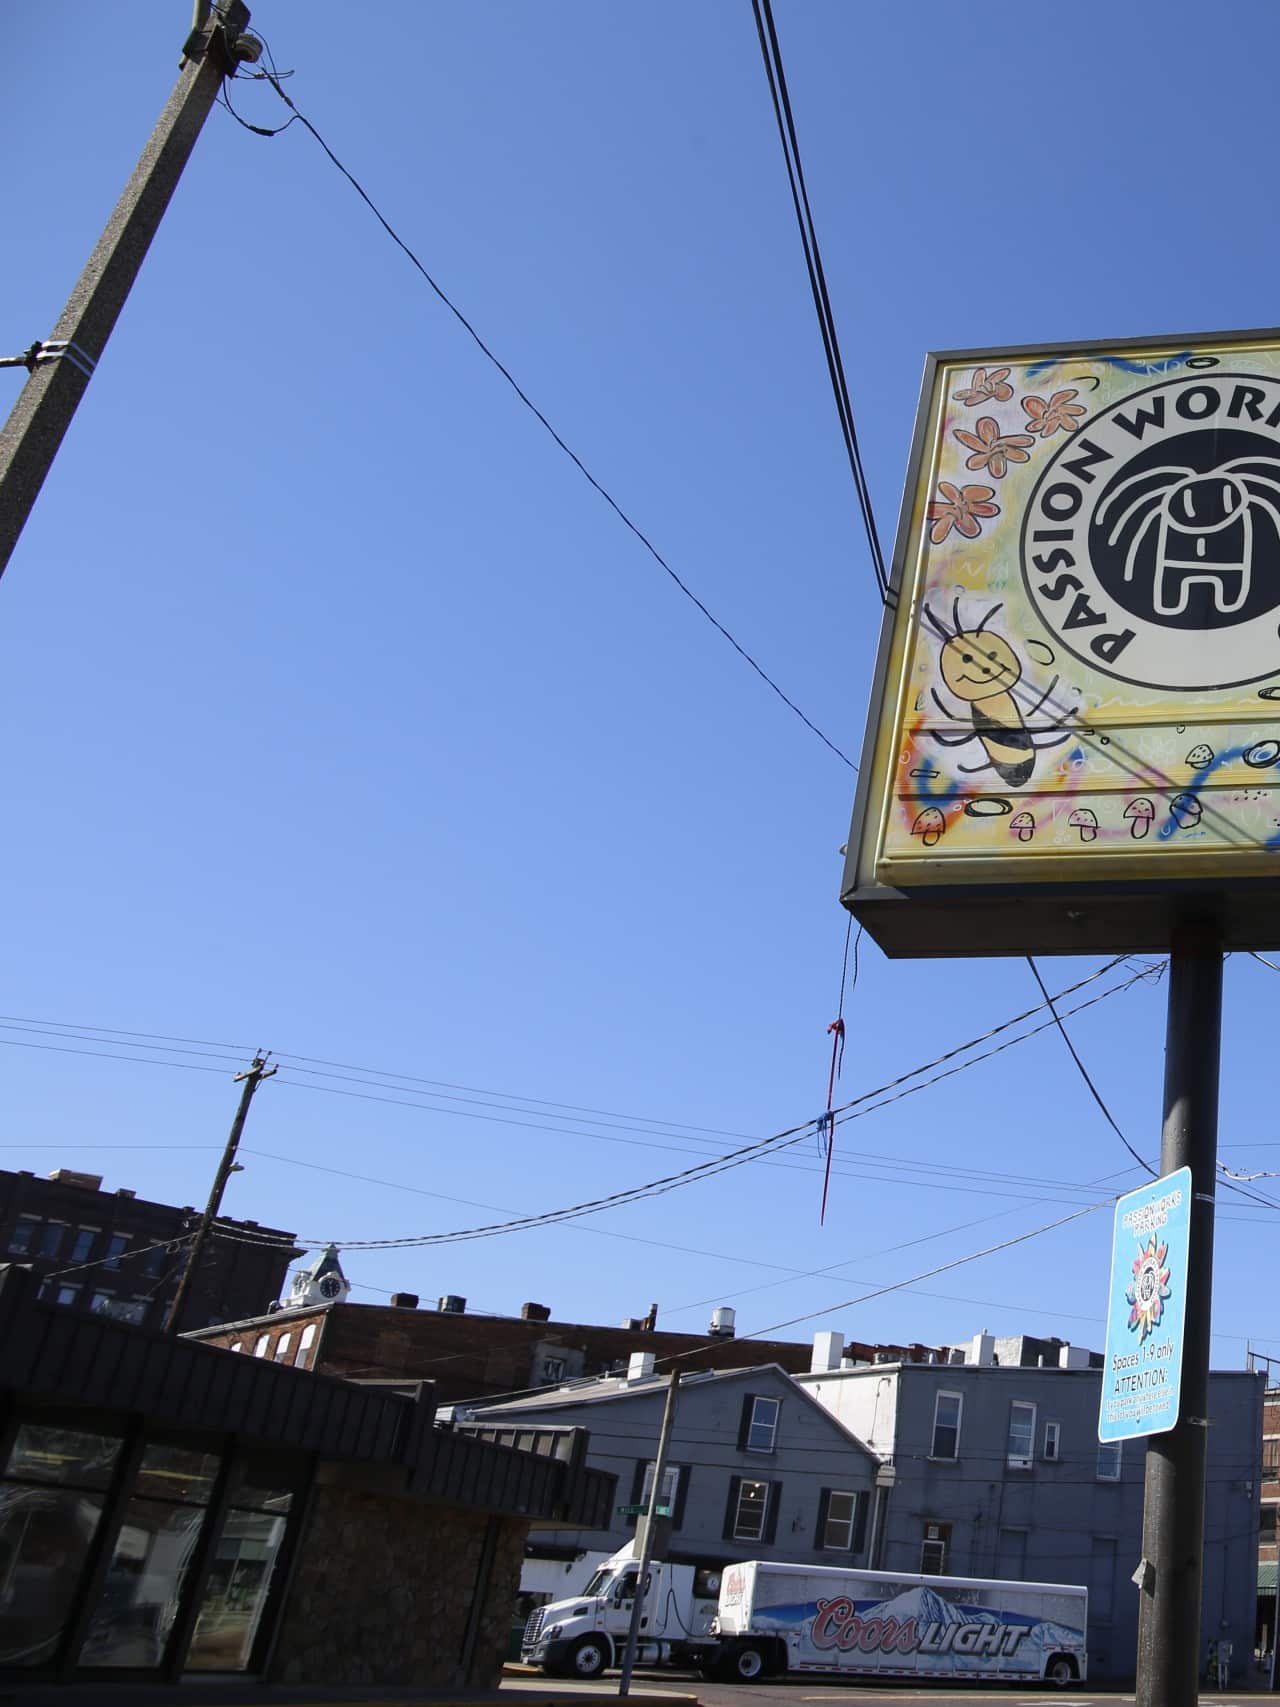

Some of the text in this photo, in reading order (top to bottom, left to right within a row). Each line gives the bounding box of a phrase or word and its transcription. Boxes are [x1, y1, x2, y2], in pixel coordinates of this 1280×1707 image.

[1033, 439, 1135, 664] PASSION
[1113, 1337, 1174, 1375] Spaces 1-9 only
[1114, 1368, 1168, 1393] ATTENTION:
[811, 1595, 1032, 1656] Coors LIGHT
